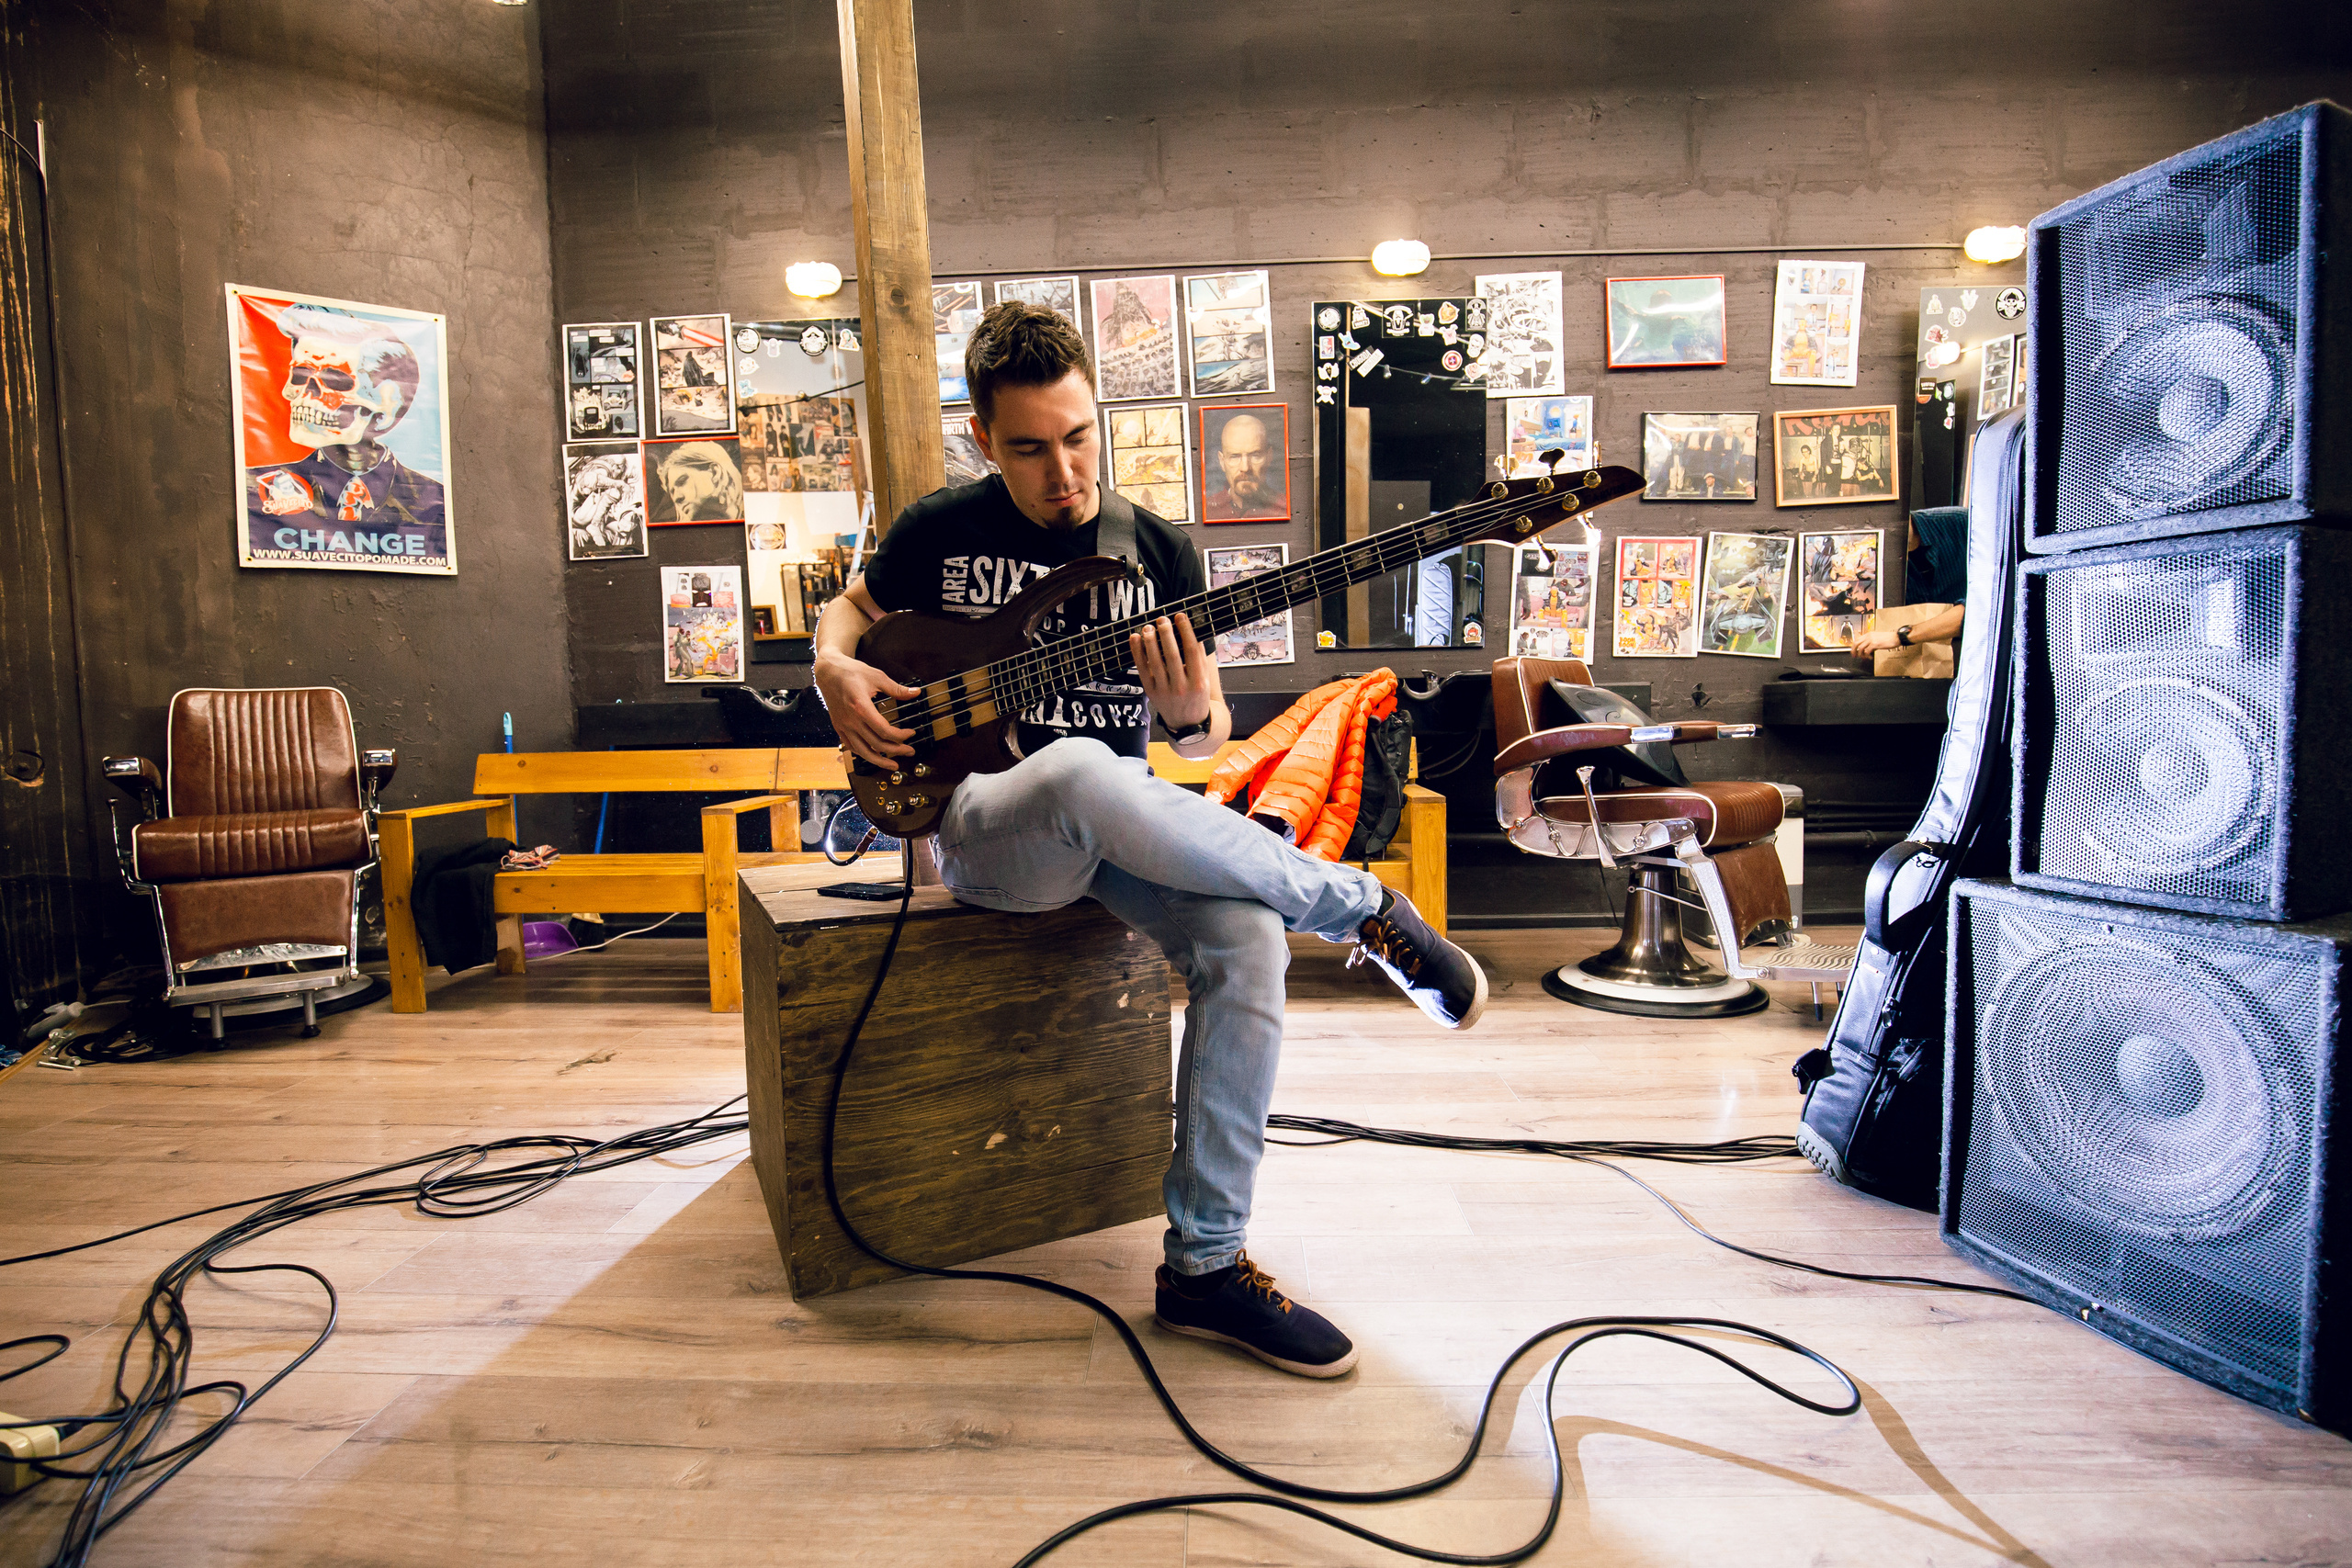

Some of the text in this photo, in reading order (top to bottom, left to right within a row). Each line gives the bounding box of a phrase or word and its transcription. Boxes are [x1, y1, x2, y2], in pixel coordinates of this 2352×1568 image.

[253, 548, 447, 567] WWW.SUAVECITOPOMADE.COM
[274, 527, 425, 556] CHANGE
[942, 555, 969, 604] AREA
[969, 555, 1065, 615] SIXT
